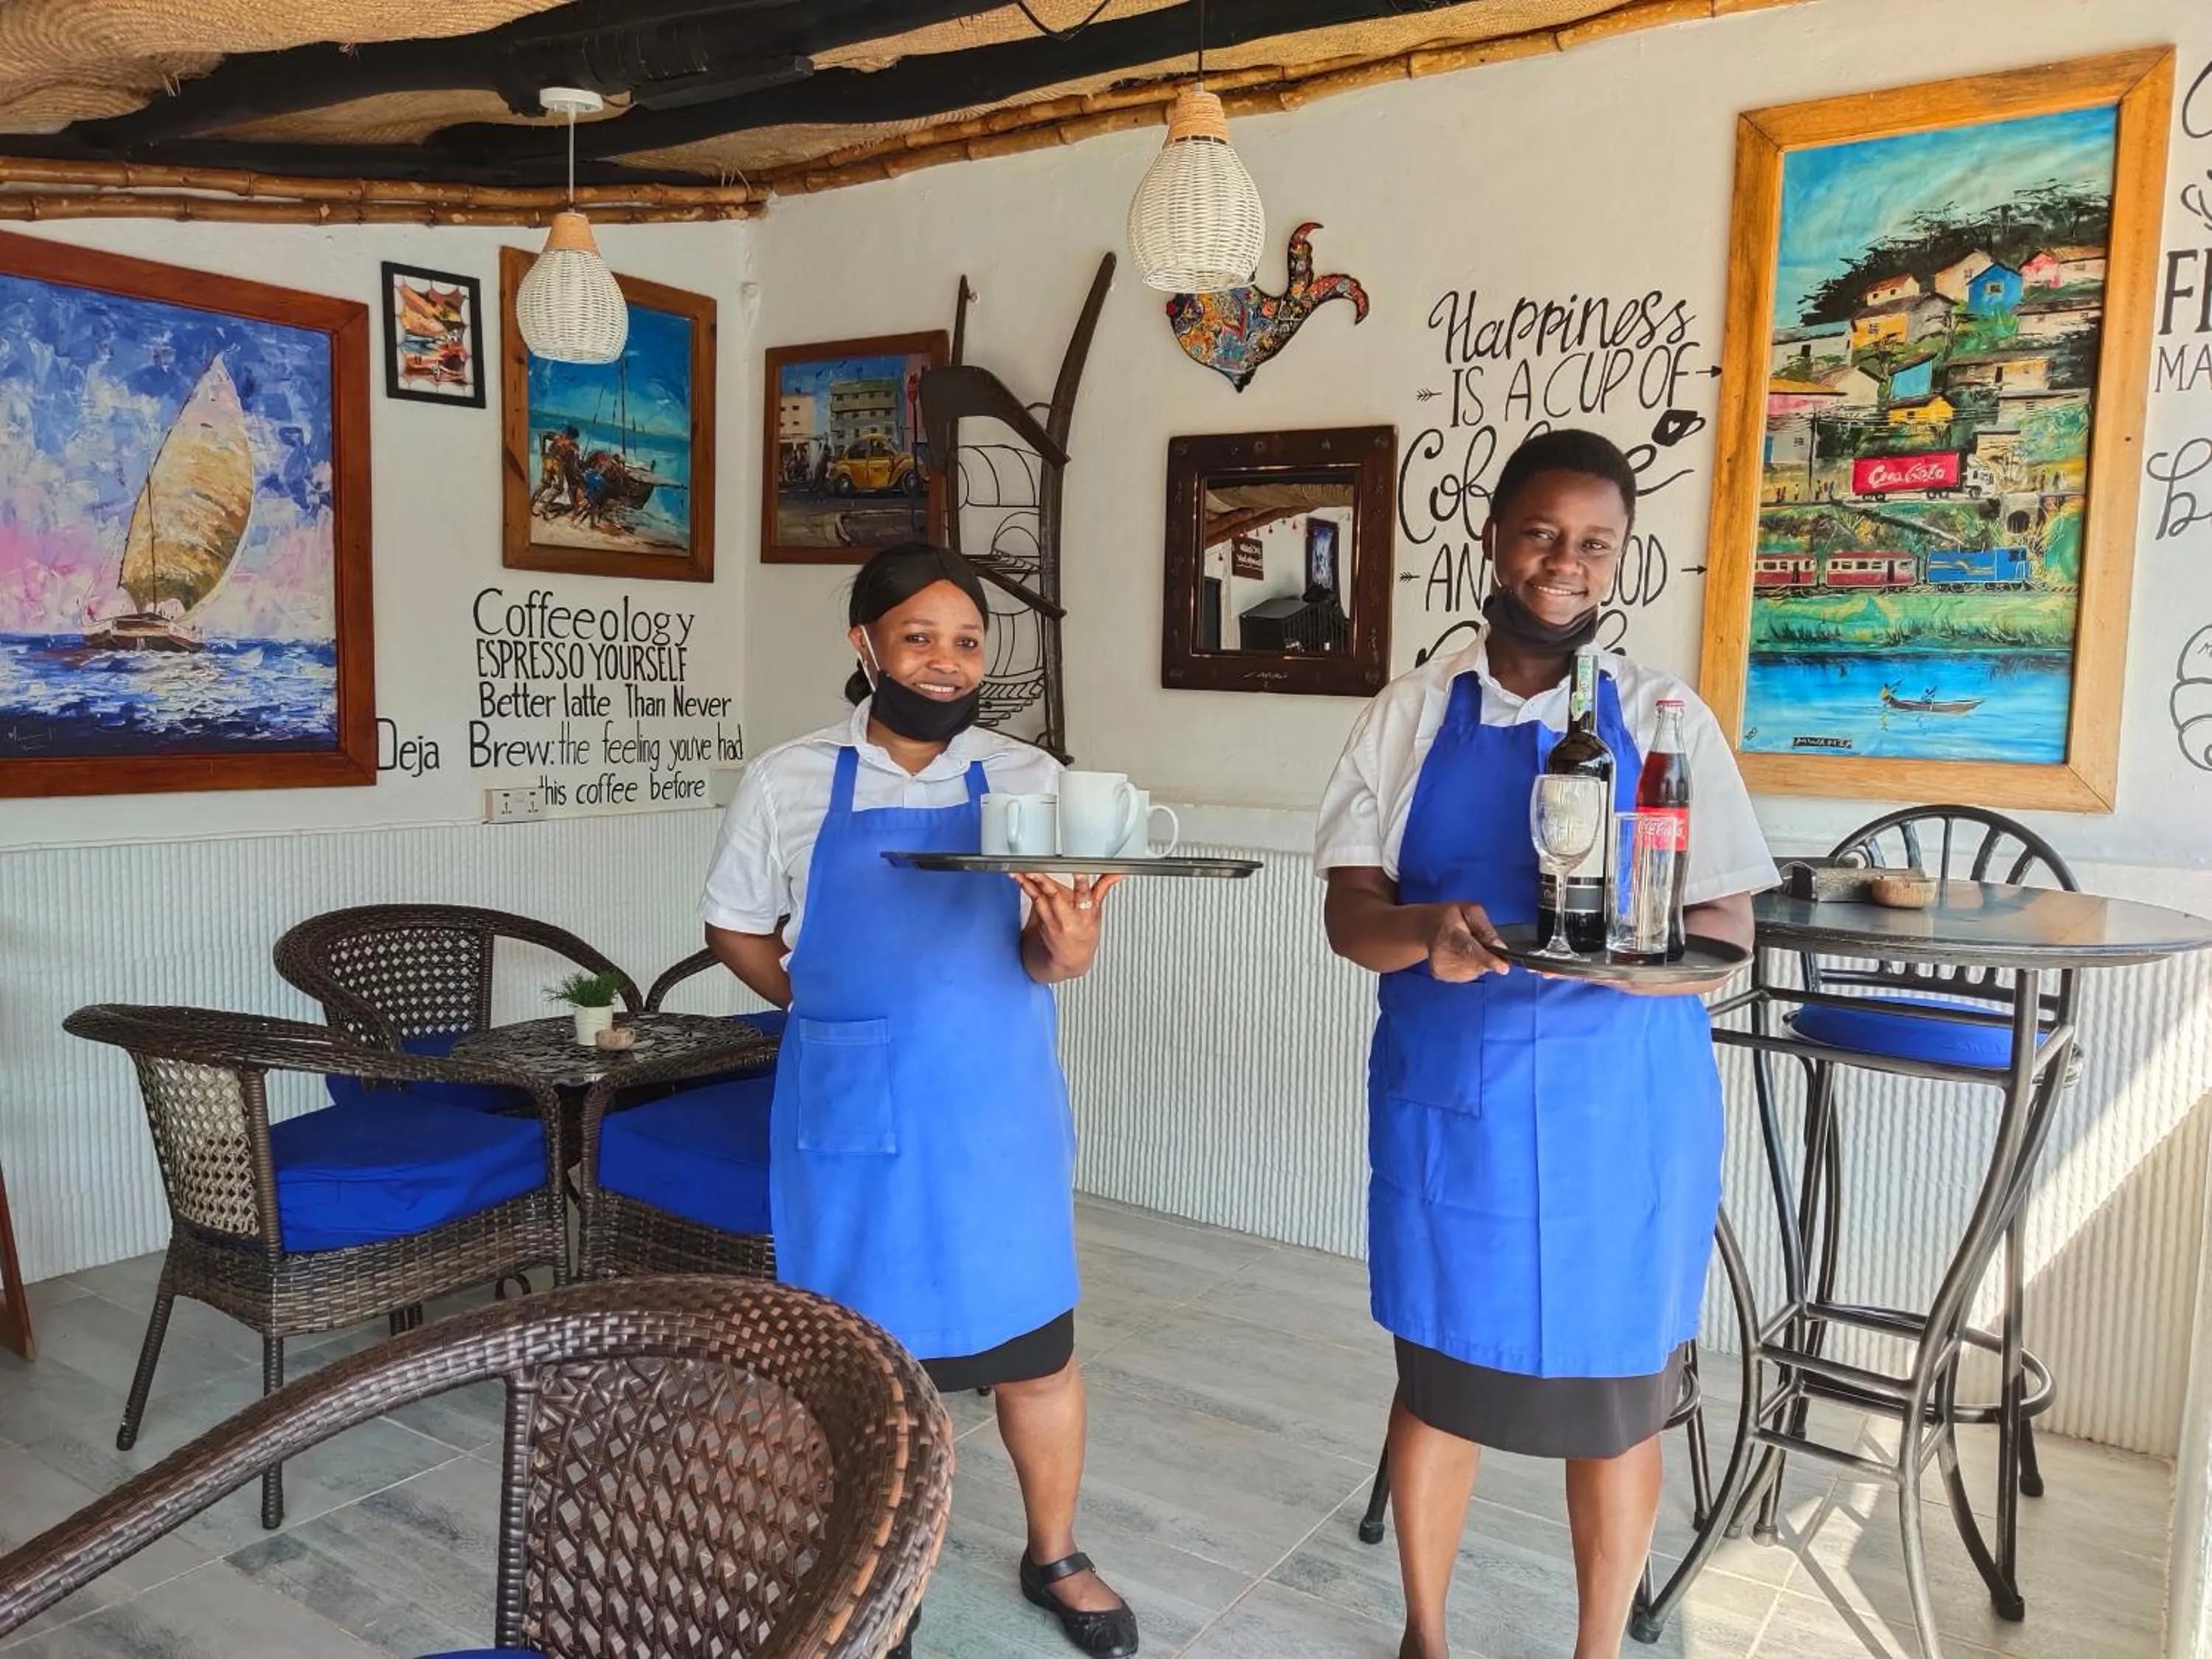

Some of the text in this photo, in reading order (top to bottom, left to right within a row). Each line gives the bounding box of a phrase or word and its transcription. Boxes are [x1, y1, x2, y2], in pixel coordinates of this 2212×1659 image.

[1428, 290, 1697, 364] Happiness
[1450, 342, 1700, 428] IS A CUP OF
[1398, 420, 1694, 544] Cofe
[473, 588, 695, 647] Coffeeology
[476, 638, 687, 682] ESPRESSO YOURSELF
[479, 681, 731, 719] Better latte Than Never
[376, 717, 440, 777] Deja
[602, 720, 660, 772] feeling
[717, 721, 743, 761] had
[538, 771, 705, 806] this coffee before
